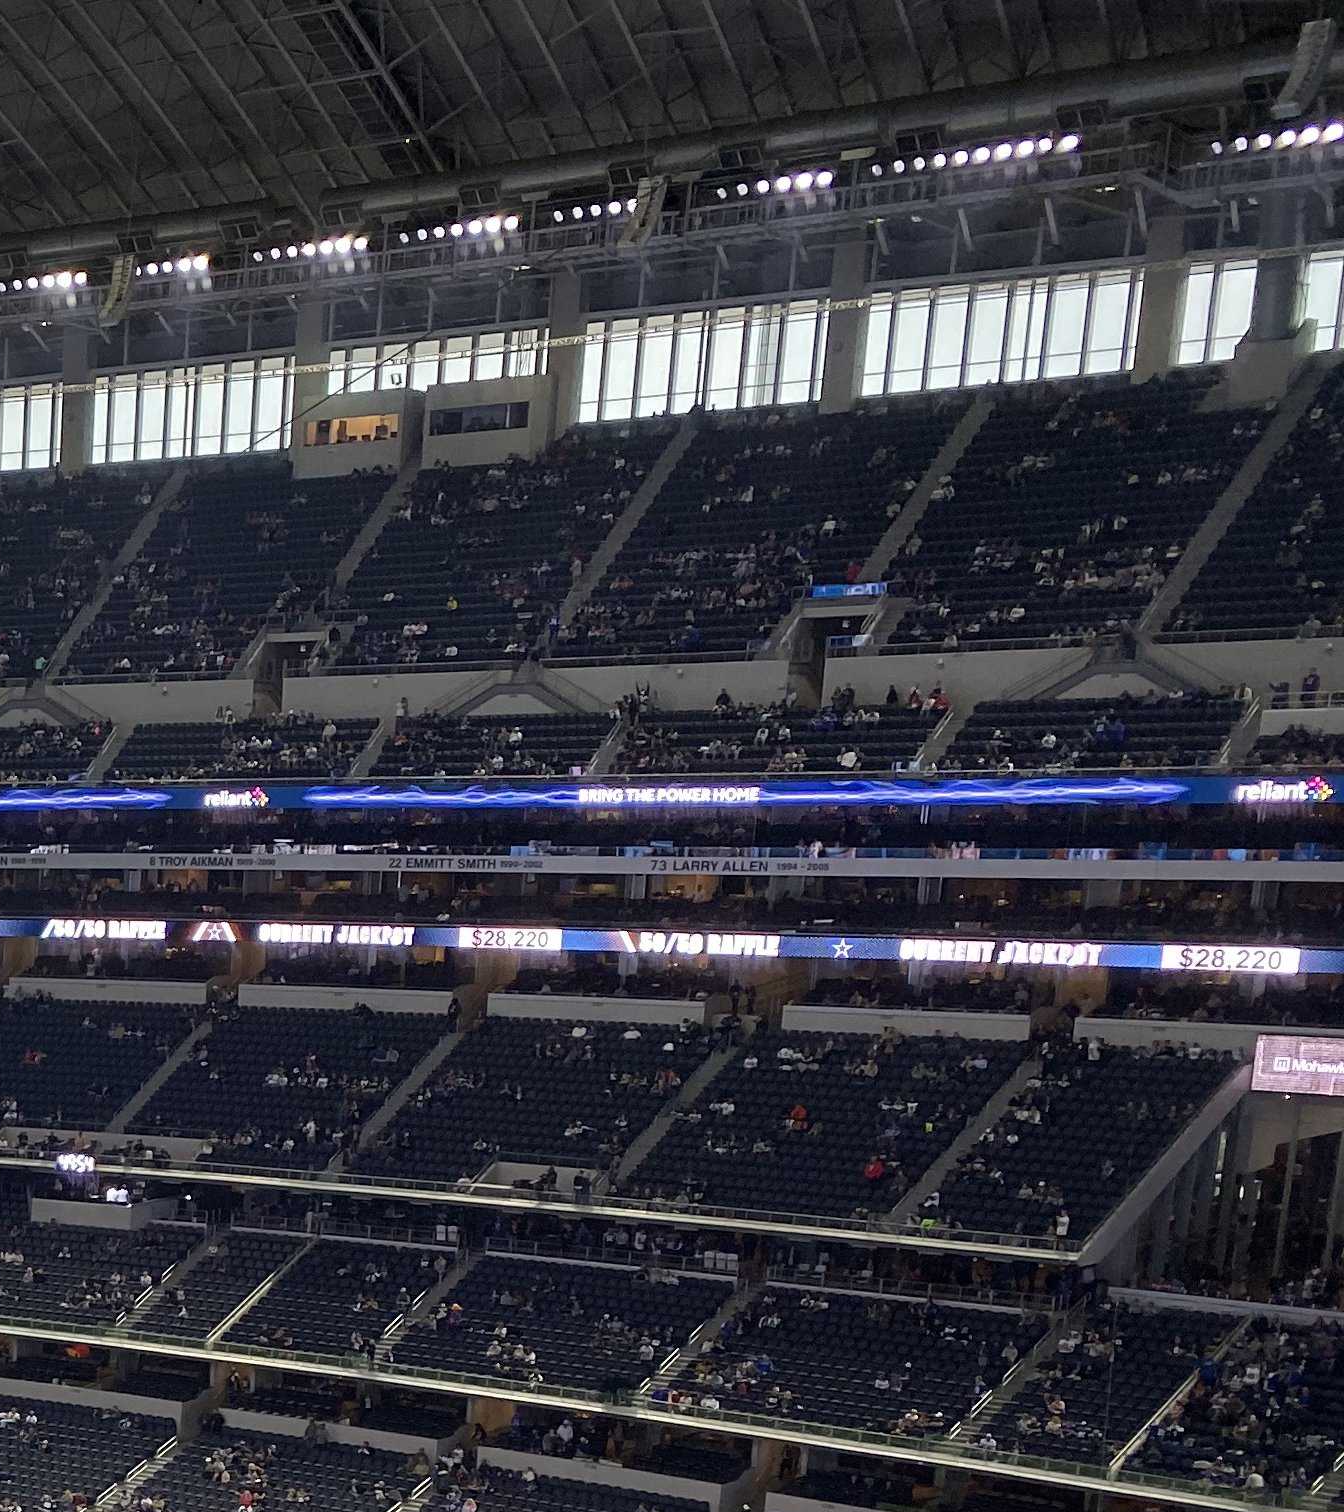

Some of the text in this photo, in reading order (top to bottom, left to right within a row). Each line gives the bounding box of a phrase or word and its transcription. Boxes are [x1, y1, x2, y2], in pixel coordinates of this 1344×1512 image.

[204, 789, 251, 806] reliant
[579, 787, 760, 803] BRING THE POWER HOME
[1237, 779, 1309, 802] reliant
[159, 856, 188, 868] TROY
[190, 856, 233, 868] AIKMAN
[388, 857, 402, 870] 22
[406, 857, 454, 870] EMMITT
[457, 857, 496, 870] SMITH
[650, 859, 668, 872] 73
[672, 859, 718, 873] LARRY
[721, 859, 768, 873] ALLEN
[337, 925, 415, 946] JACKPOT
[472, 929, 549, 949] $28,220
[639, 931, 780, 957] 50/50 RAFFLE
[900, 938, 1102, 967] CURRENT JACKPOT
[1179, 946, 1282, 970] $28,220
